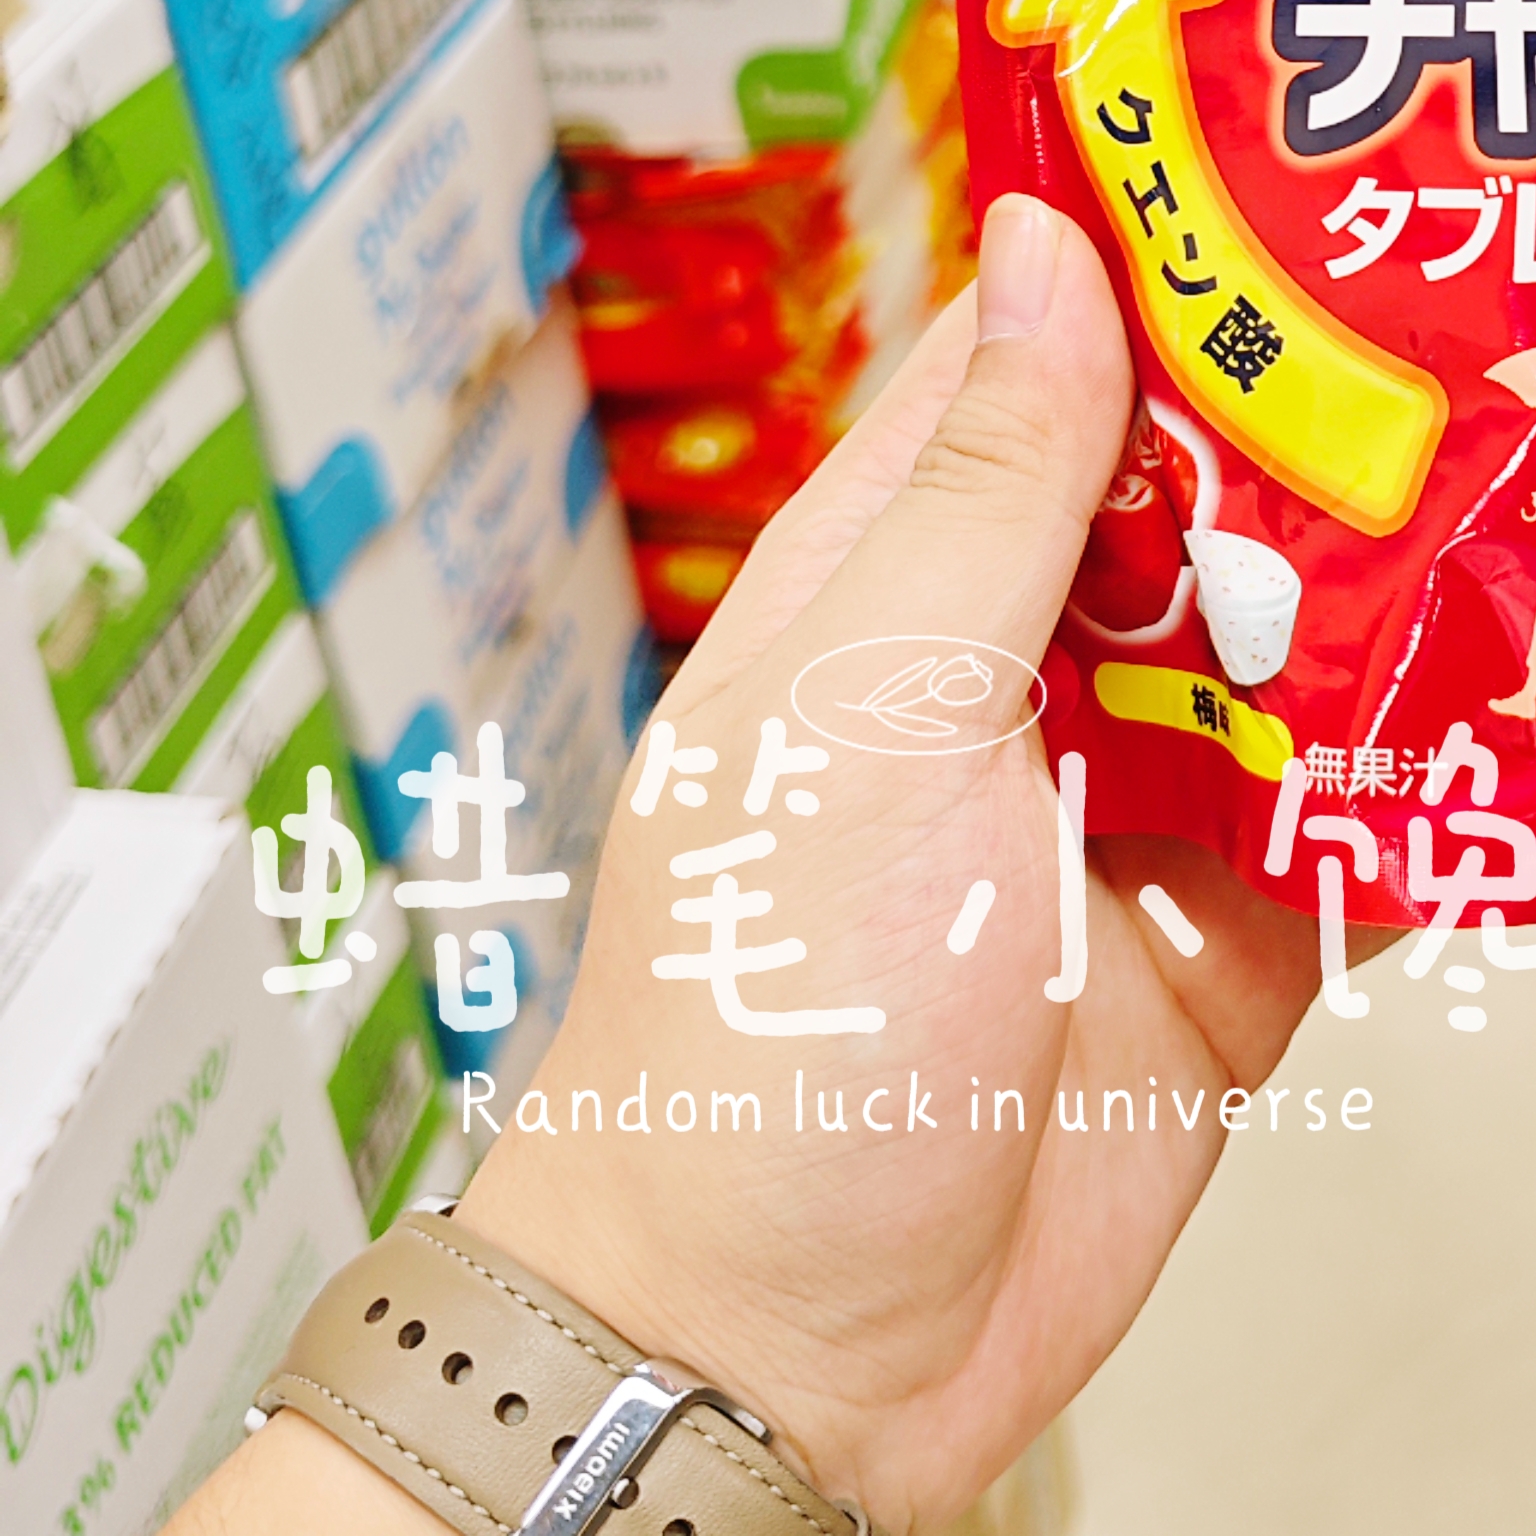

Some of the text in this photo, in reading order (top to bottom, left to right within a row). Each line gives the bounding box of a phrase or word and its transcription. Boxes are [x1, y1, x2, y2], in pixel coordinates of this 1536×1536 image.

[1096, 86, 1284, 394] クエン酸
[1305, 741, 1450, 799] 無果汁
[0, 1036, 232, 1465] Digestive
[112, 1206, 243, 1454] REDUCED
[243, 1114, 287, 1215] FAT
[552, 1421, 631, 1522] xiaomi
